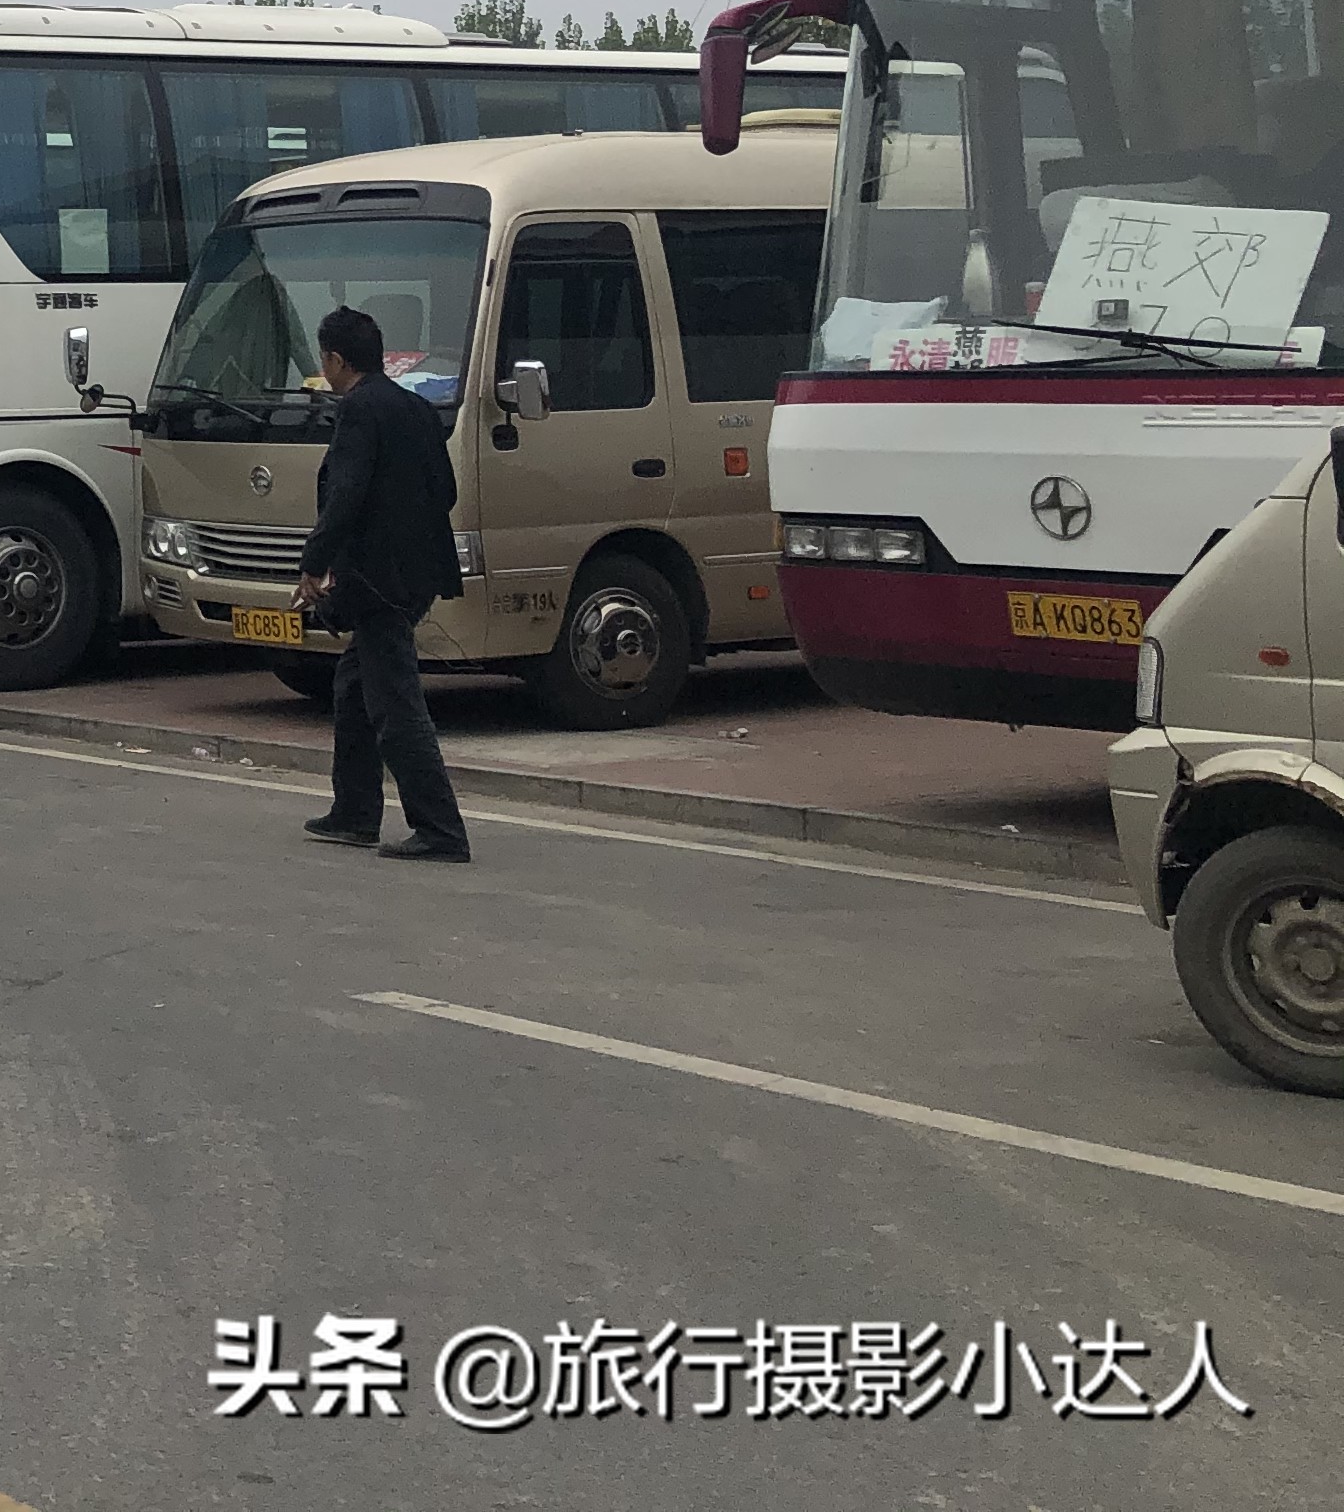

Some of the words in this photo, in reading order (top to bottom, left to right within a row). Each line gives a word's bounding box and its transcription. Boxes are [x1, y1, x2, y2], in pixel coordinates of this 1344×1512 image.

[1082, 212, 1267, 308] 燕郊
[35, 292, 99, 309] 宇通客车
